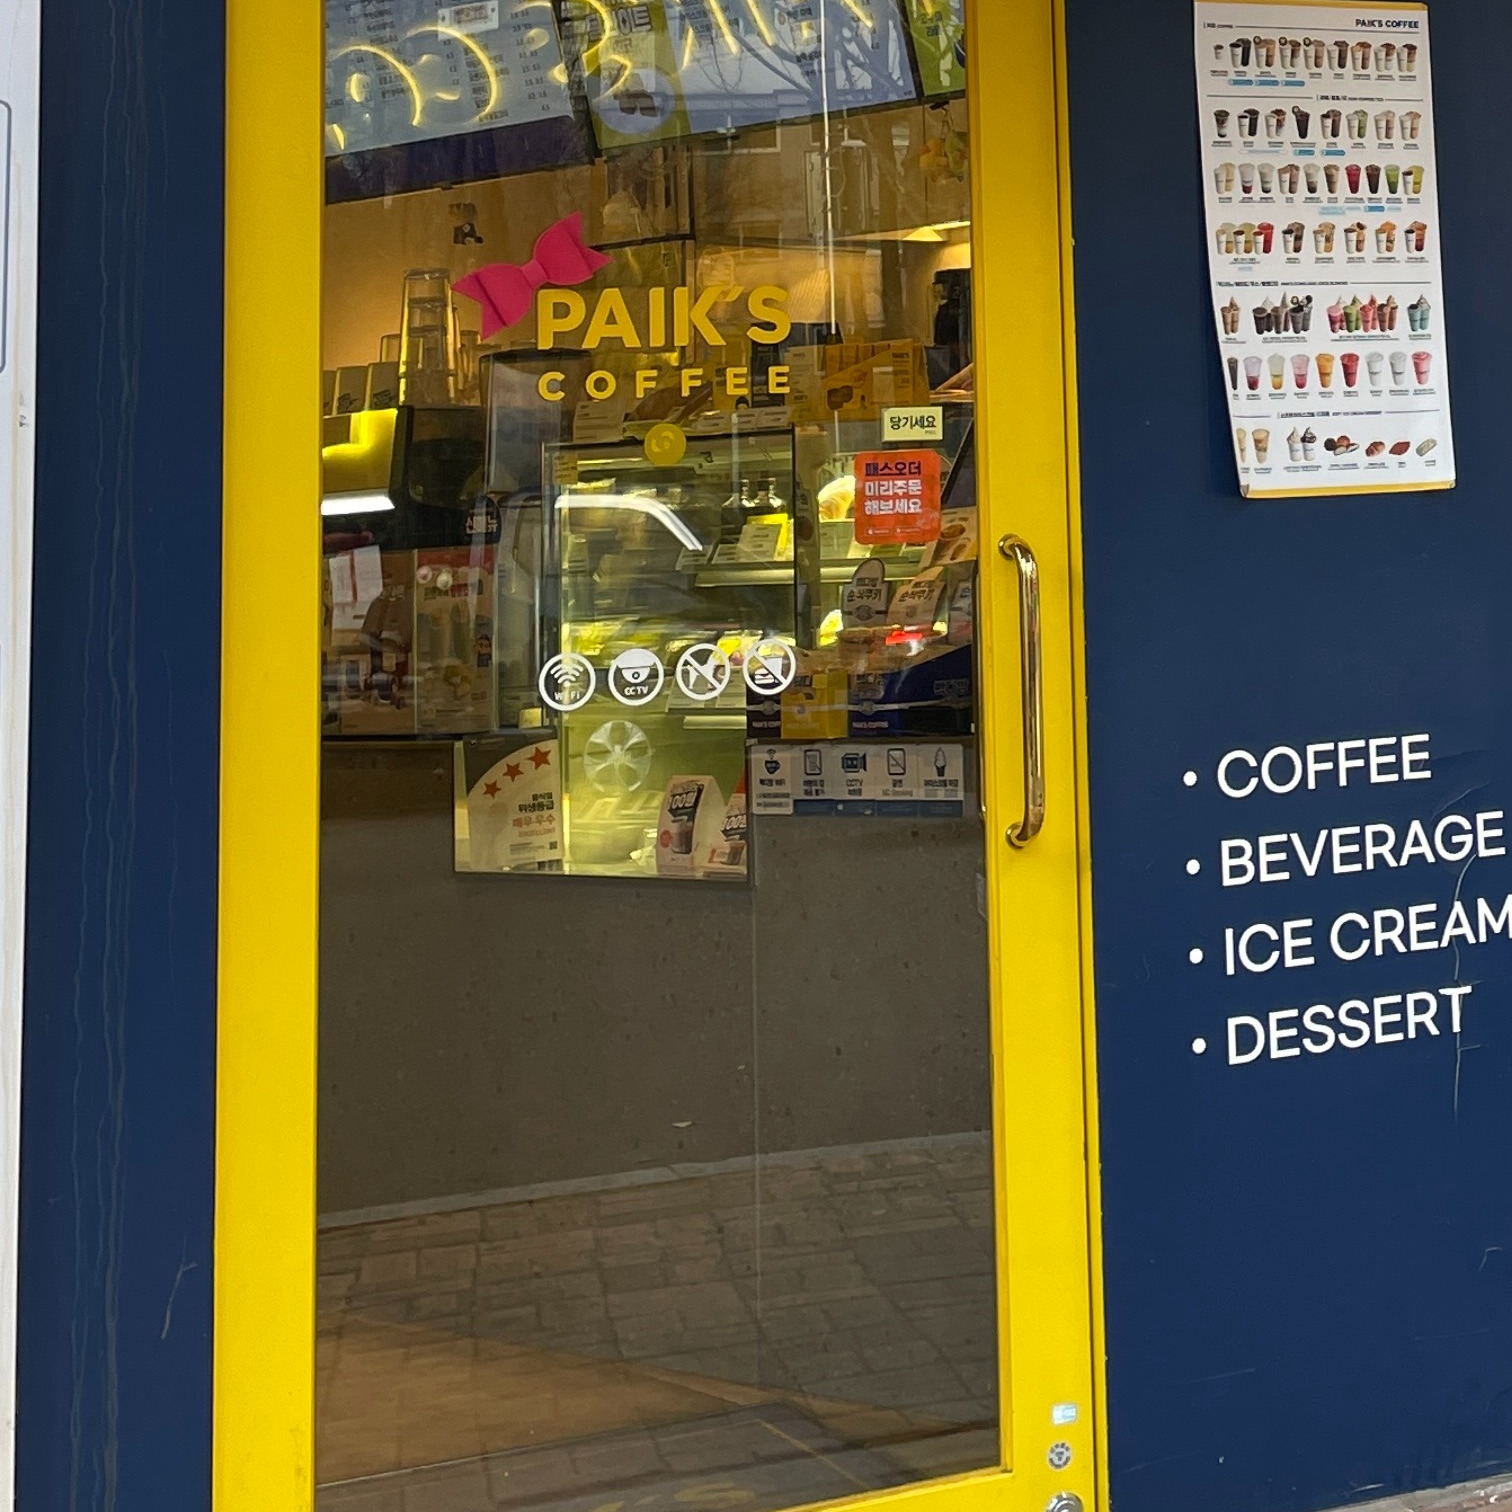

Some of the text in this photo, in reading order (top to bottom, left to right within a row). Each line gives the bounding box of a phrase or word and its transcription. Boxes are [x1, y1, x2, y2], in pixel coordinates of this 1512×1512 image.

[1355, 18, 1420, 30] PAIK'S COFFEE
[536, 285, 791, 350] PAIK'S
[537, 363, 792, 401] COFFEE
[890, 415, 936, 430] 당기세요
[865, 461, 922, 476] 패스오더
[865, 479, 922, 497] 미리주문
[864, 498, 922, 515] 해보세요
[623, 686, 649, 697] CCTV
[1216, 732, 1432, 799] COFFEE
[1220, 809, 1507, 887] BEVERAGE
[1224, 917, 1315, 976] ICE
[1226, 985, 1472, 1066] DESSERT
